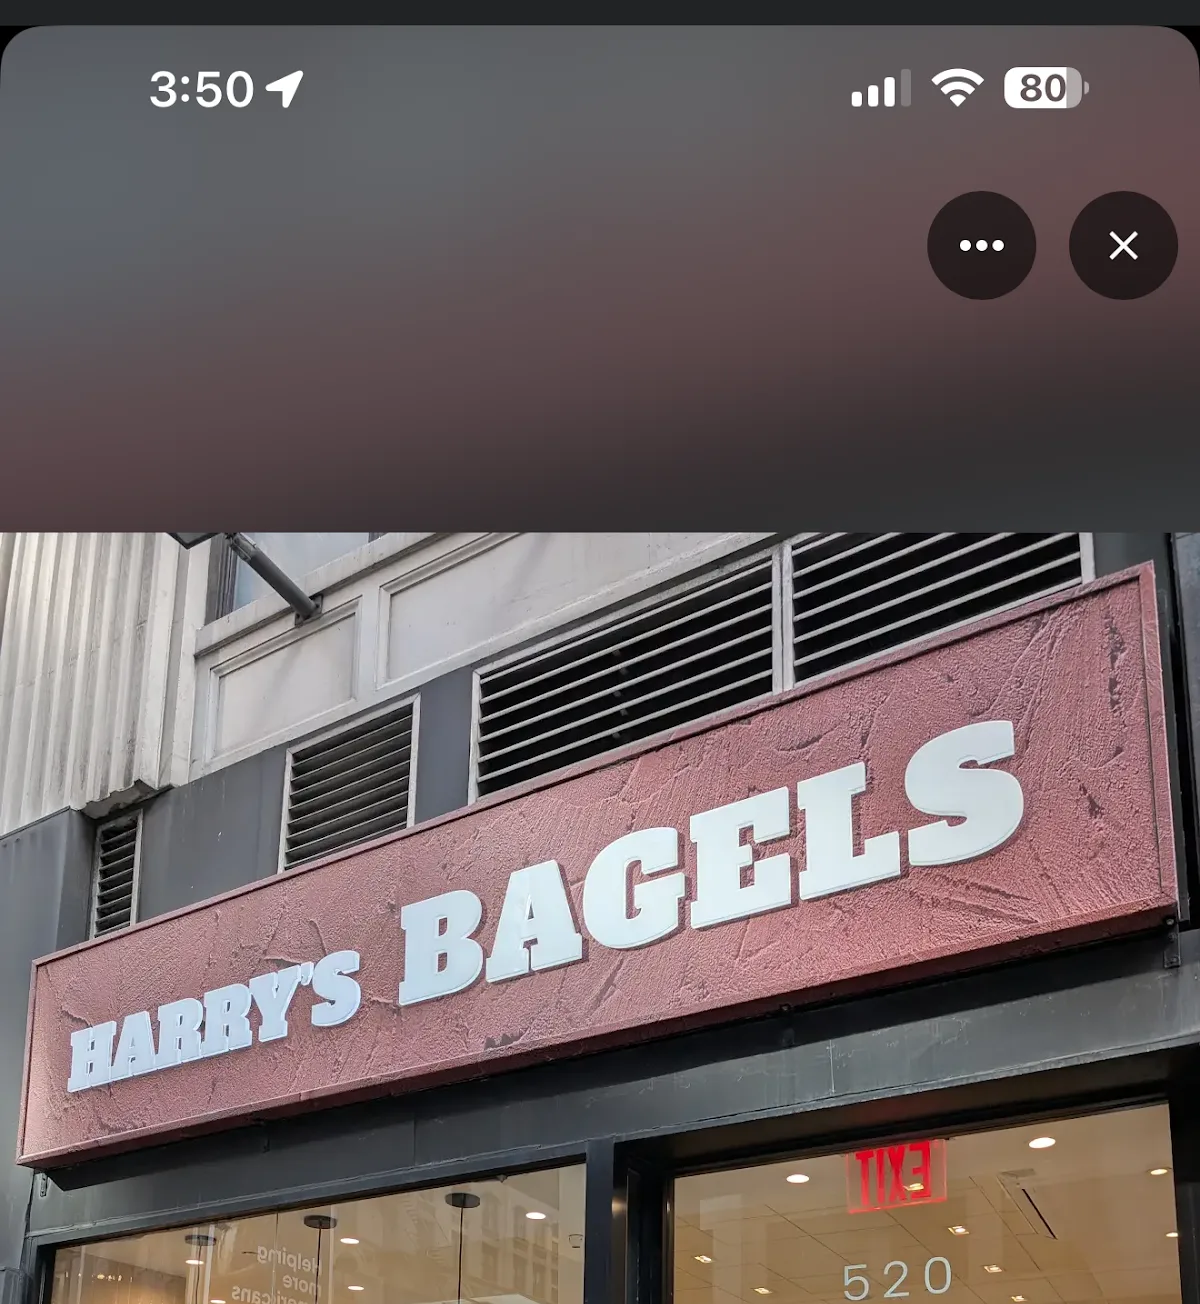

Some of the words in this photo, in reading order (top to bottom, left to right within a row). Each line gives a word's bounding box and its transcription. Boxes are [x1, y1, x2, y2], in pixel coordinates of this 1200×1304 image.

[67, 949, 361, 1093] HARRY'S
[399, 719, 1025, 1006] BAGELS
[843, 1256, 953, 1302] 520
